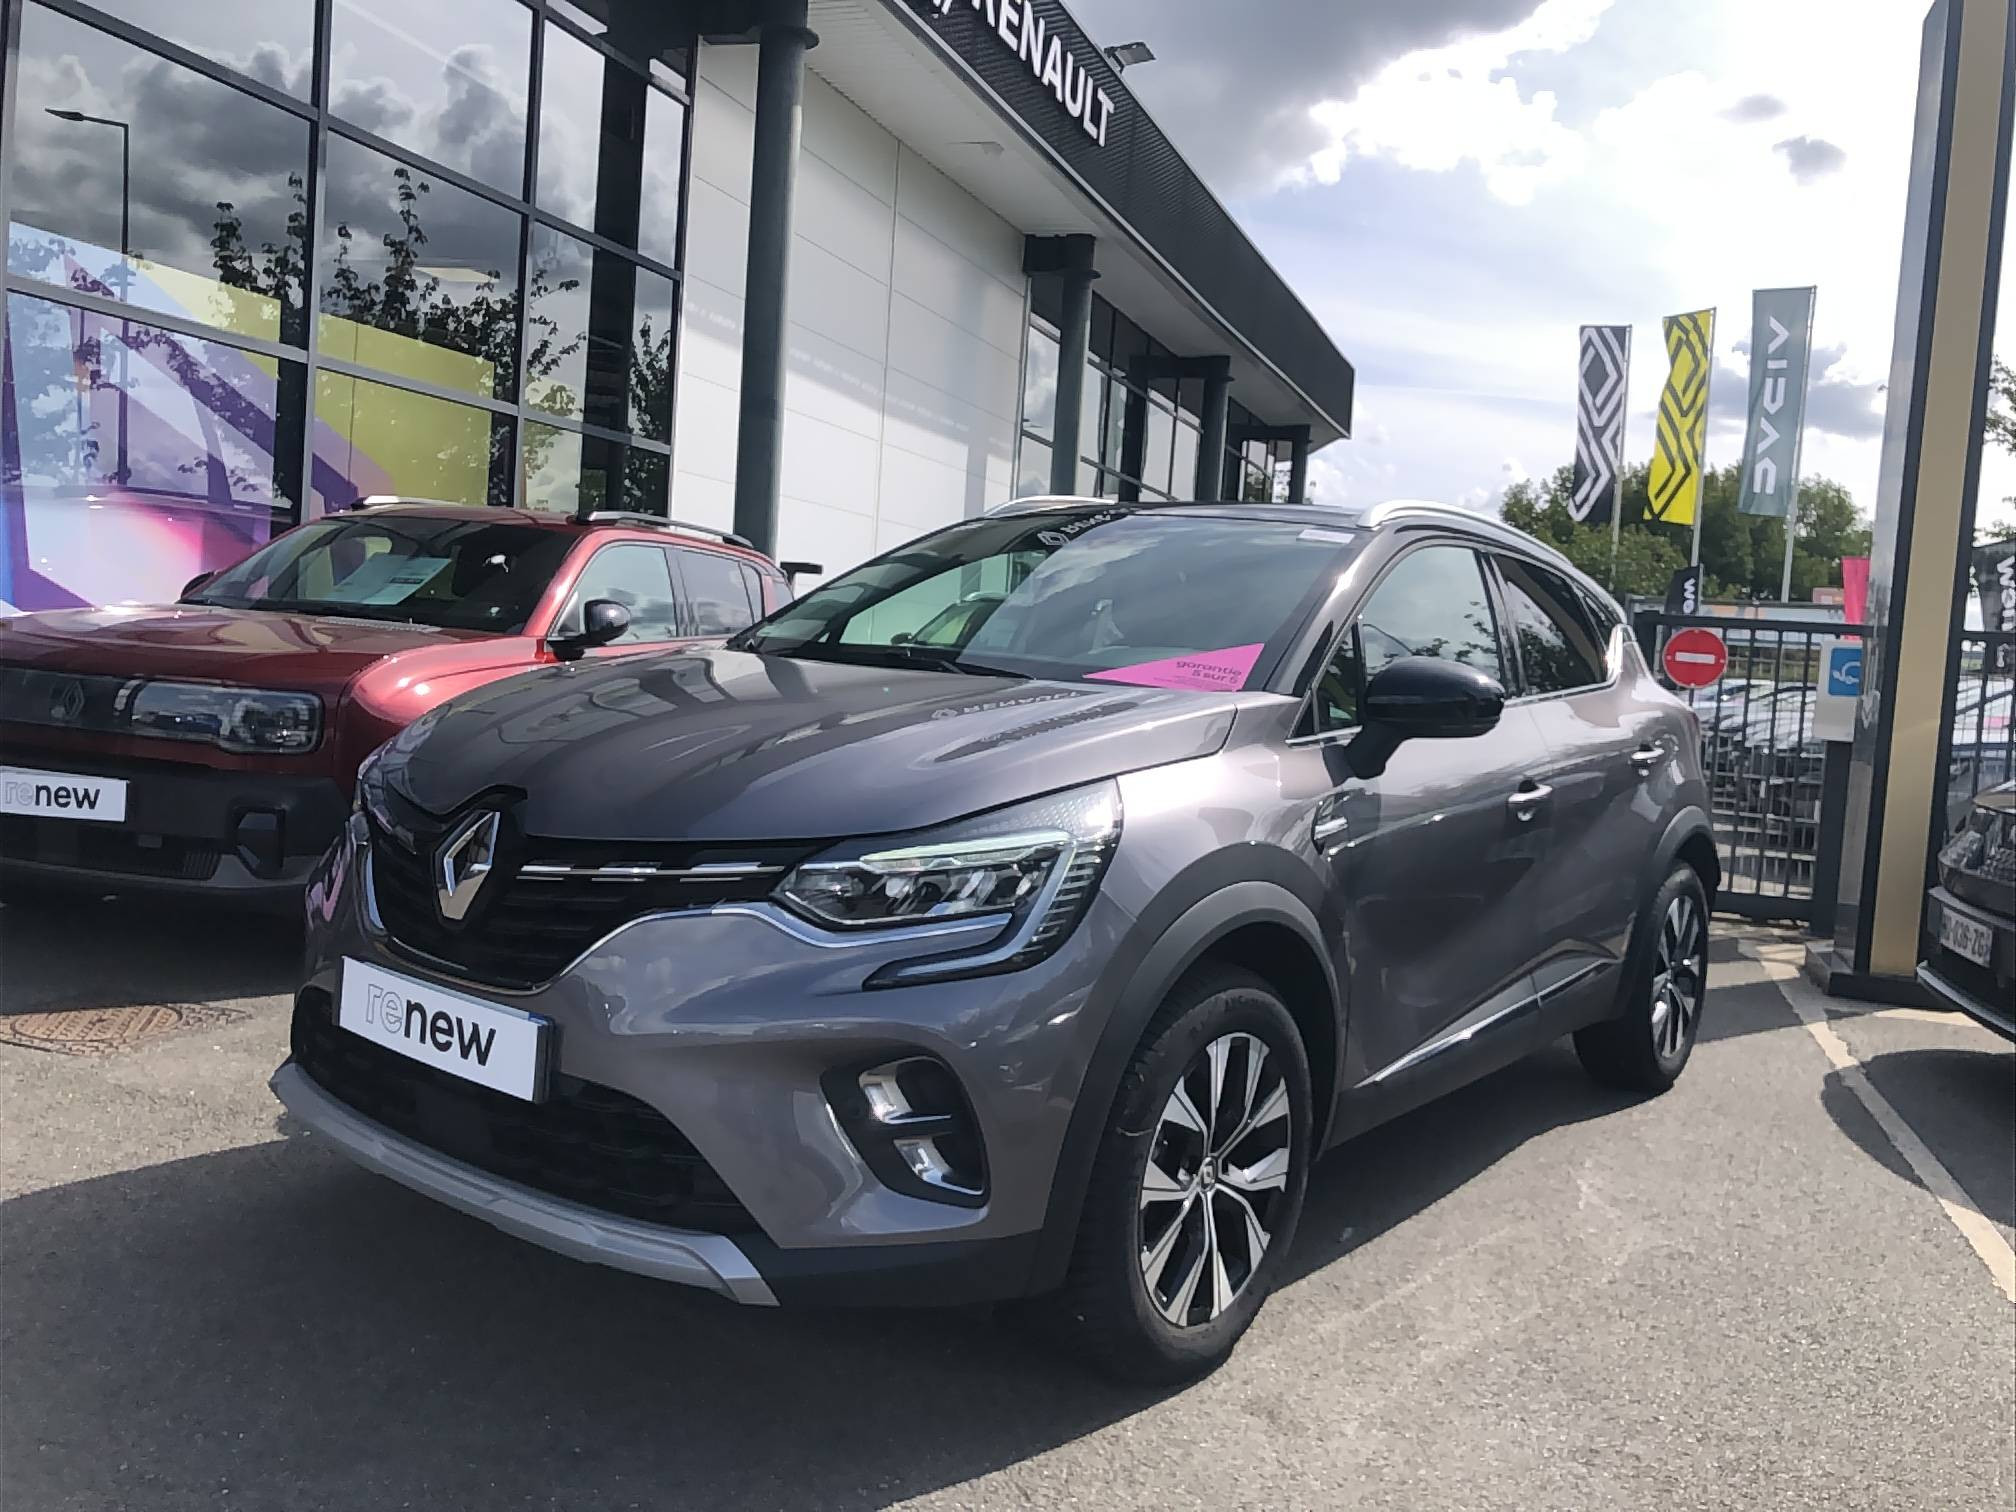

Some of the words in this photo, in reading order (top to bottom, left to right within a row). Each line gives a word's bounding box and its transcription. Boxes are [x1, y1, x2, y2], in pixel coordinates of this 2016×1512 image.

[1176, 661, 1242, 676] garantie
[1203, 672, 1227, 681] sur
[4, 780, 101, 810] renew
[366, 983, 496, 1067] renew
